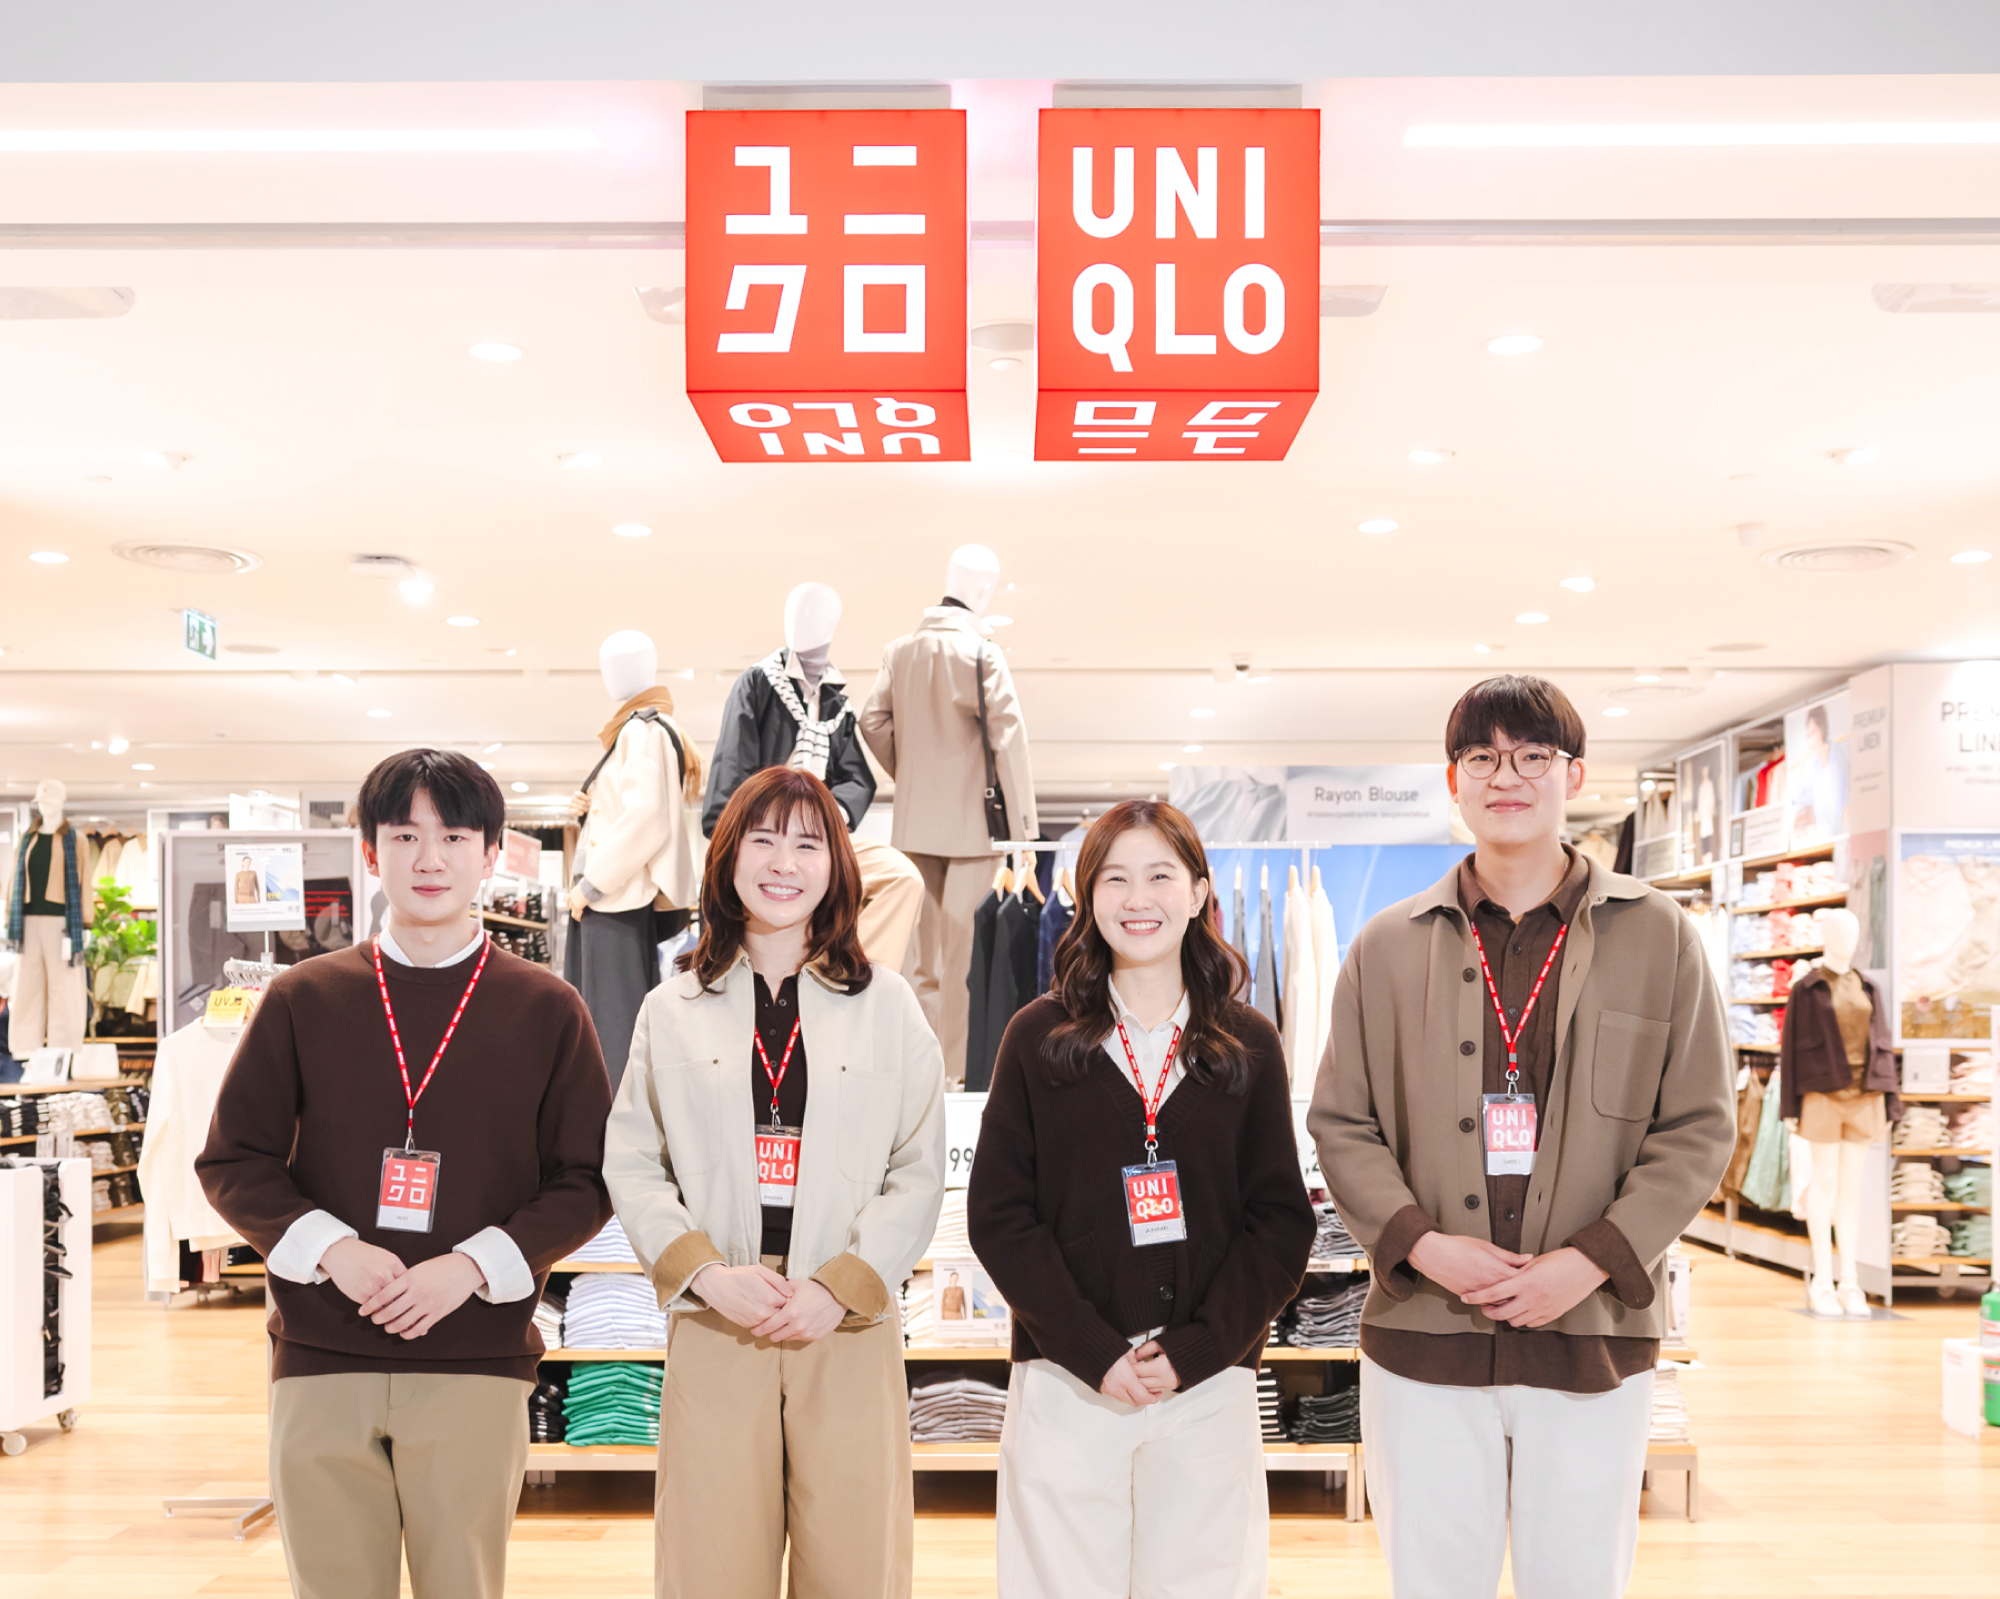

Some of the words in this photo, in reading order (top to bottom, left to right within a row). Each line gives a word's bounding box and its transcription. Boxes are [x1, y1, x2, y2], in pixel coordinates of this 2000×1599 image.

[725, 146, 926, 234] ユニ
[1072, 147, 1265, 239] UNI
[716, 264, 926, 353] クロ
[1072, 263, 1286, 372] QLO
[728, 397, 937, 428] QLO
[758, 432, 941, 455] UNI
[1960, 732, 2000, 753] LIN
[1314, 786, 1362, 805] Rayon
[1368, 786, 1419, 802] Blouse
[1492, 1109, 1527, 1126] UNI
[1492, 1129, 1531, 1149] QLO
[759, 1141, 793, 1160] UNI
[391, 1164, 427, 1184] ユニ
[758, 1161, 795, 1182] QLO
[387, 1184, 426, 1204] クロ
[1133, 1178, 1168, 1198] UNI
[1135, 1197, 1174, 1220] QLO
